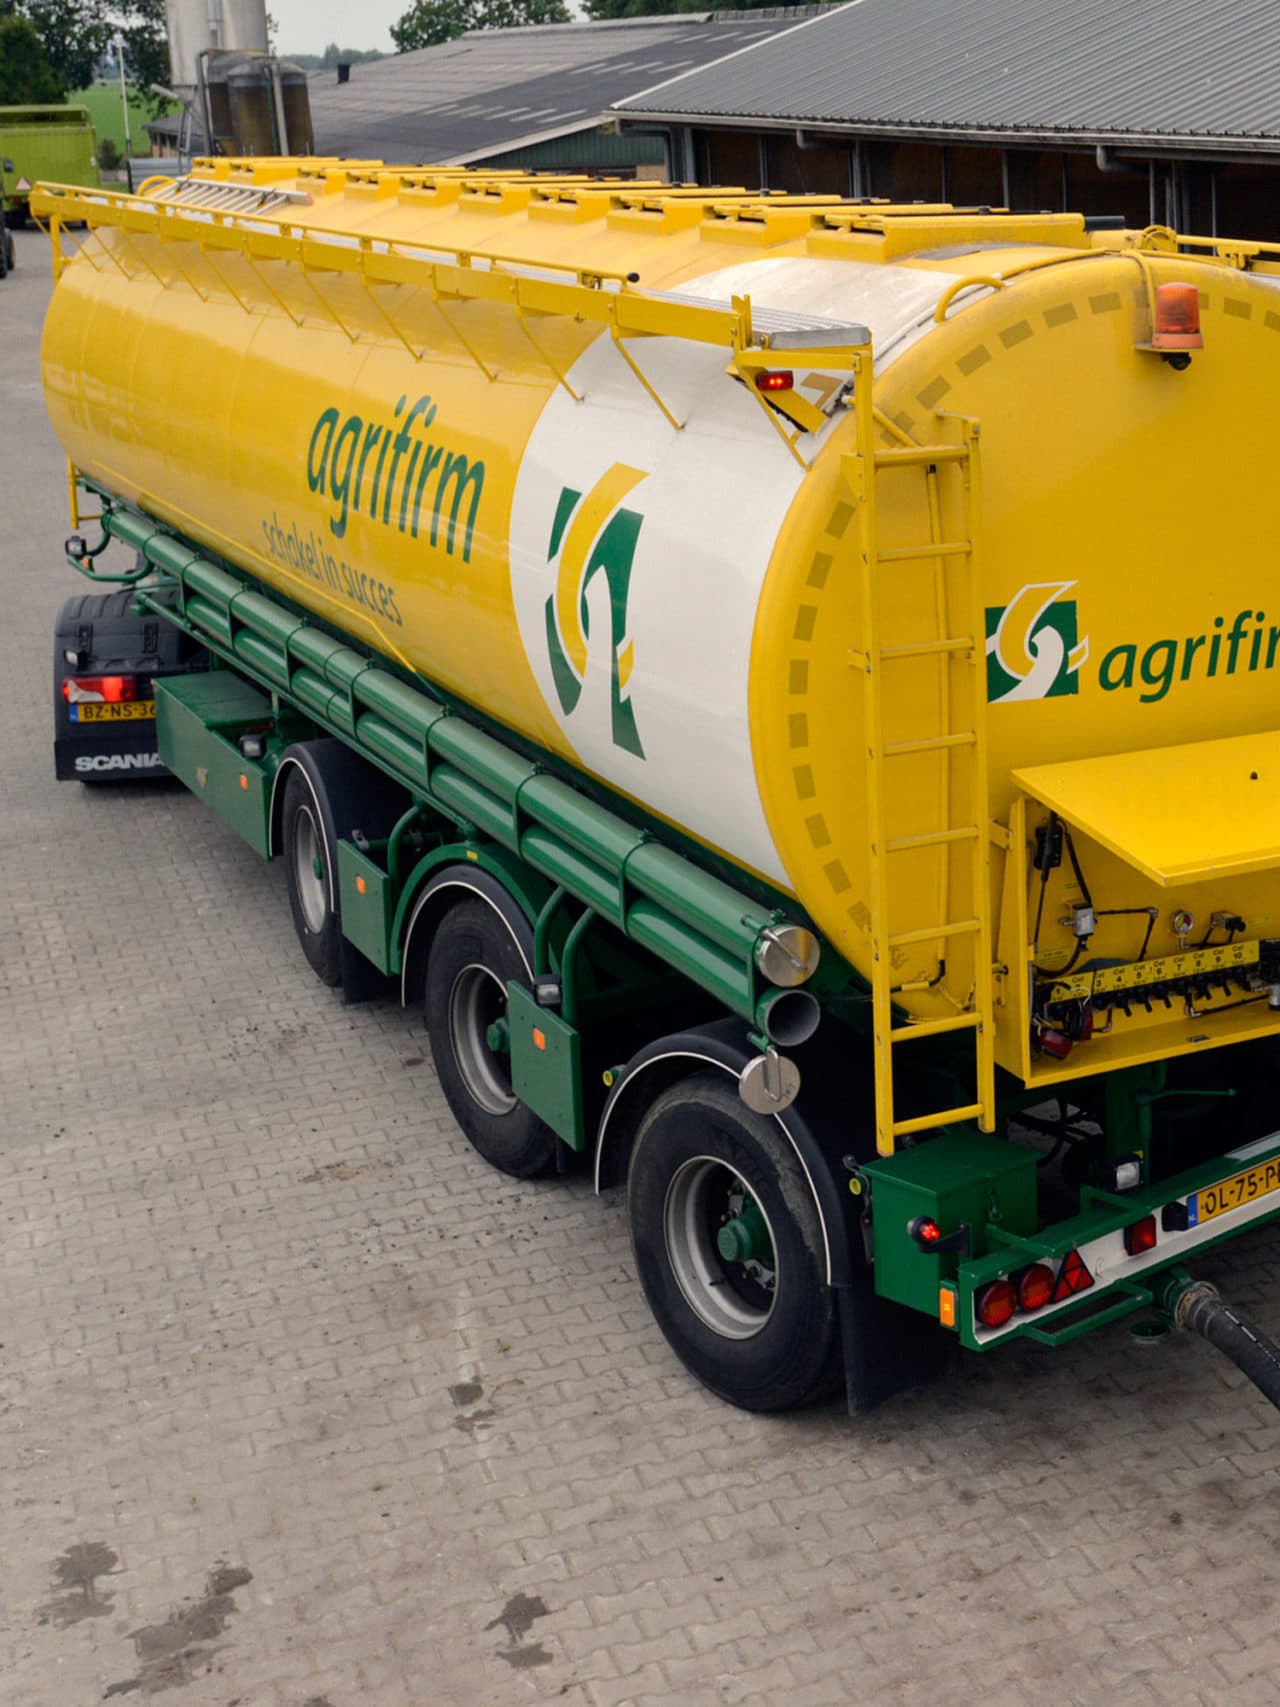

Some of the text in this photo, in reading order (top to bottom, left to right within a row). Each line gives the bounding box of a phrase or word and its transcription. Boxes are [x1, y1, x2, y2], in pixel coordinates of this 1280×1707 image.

[307, 394, 485, 564] agrifirm
[318, 537, 345, 592] in
[341, 562, 403, 627] succes
[75, 753, 165, 772] SCANIA
